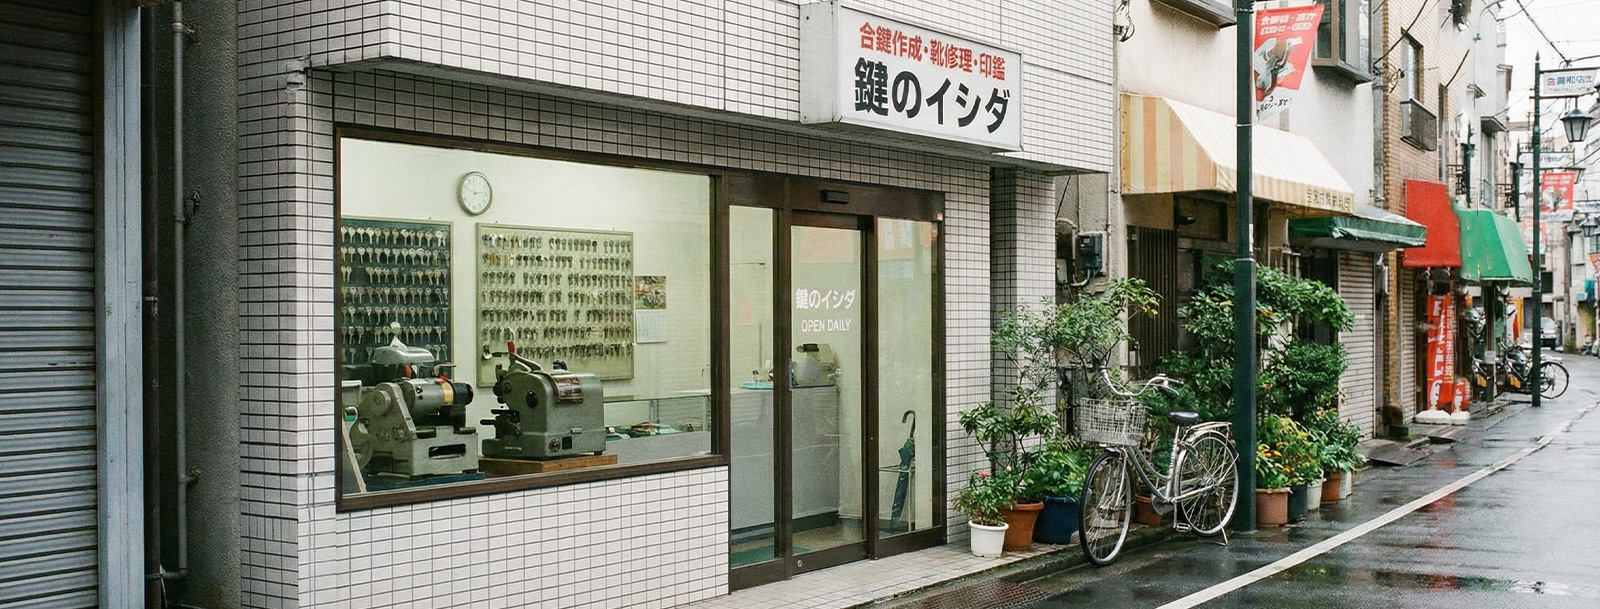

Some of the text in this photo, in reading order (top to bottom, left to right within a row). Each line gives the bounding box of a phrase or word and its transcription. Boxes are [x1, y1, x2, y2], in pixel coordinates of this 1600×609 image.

[854, 57, 1011, 134] 鍵のイシダ
[795, 288, 856, 309] 鍵のイシダ
[801, 318, 851, 332] OPEN DAILY
